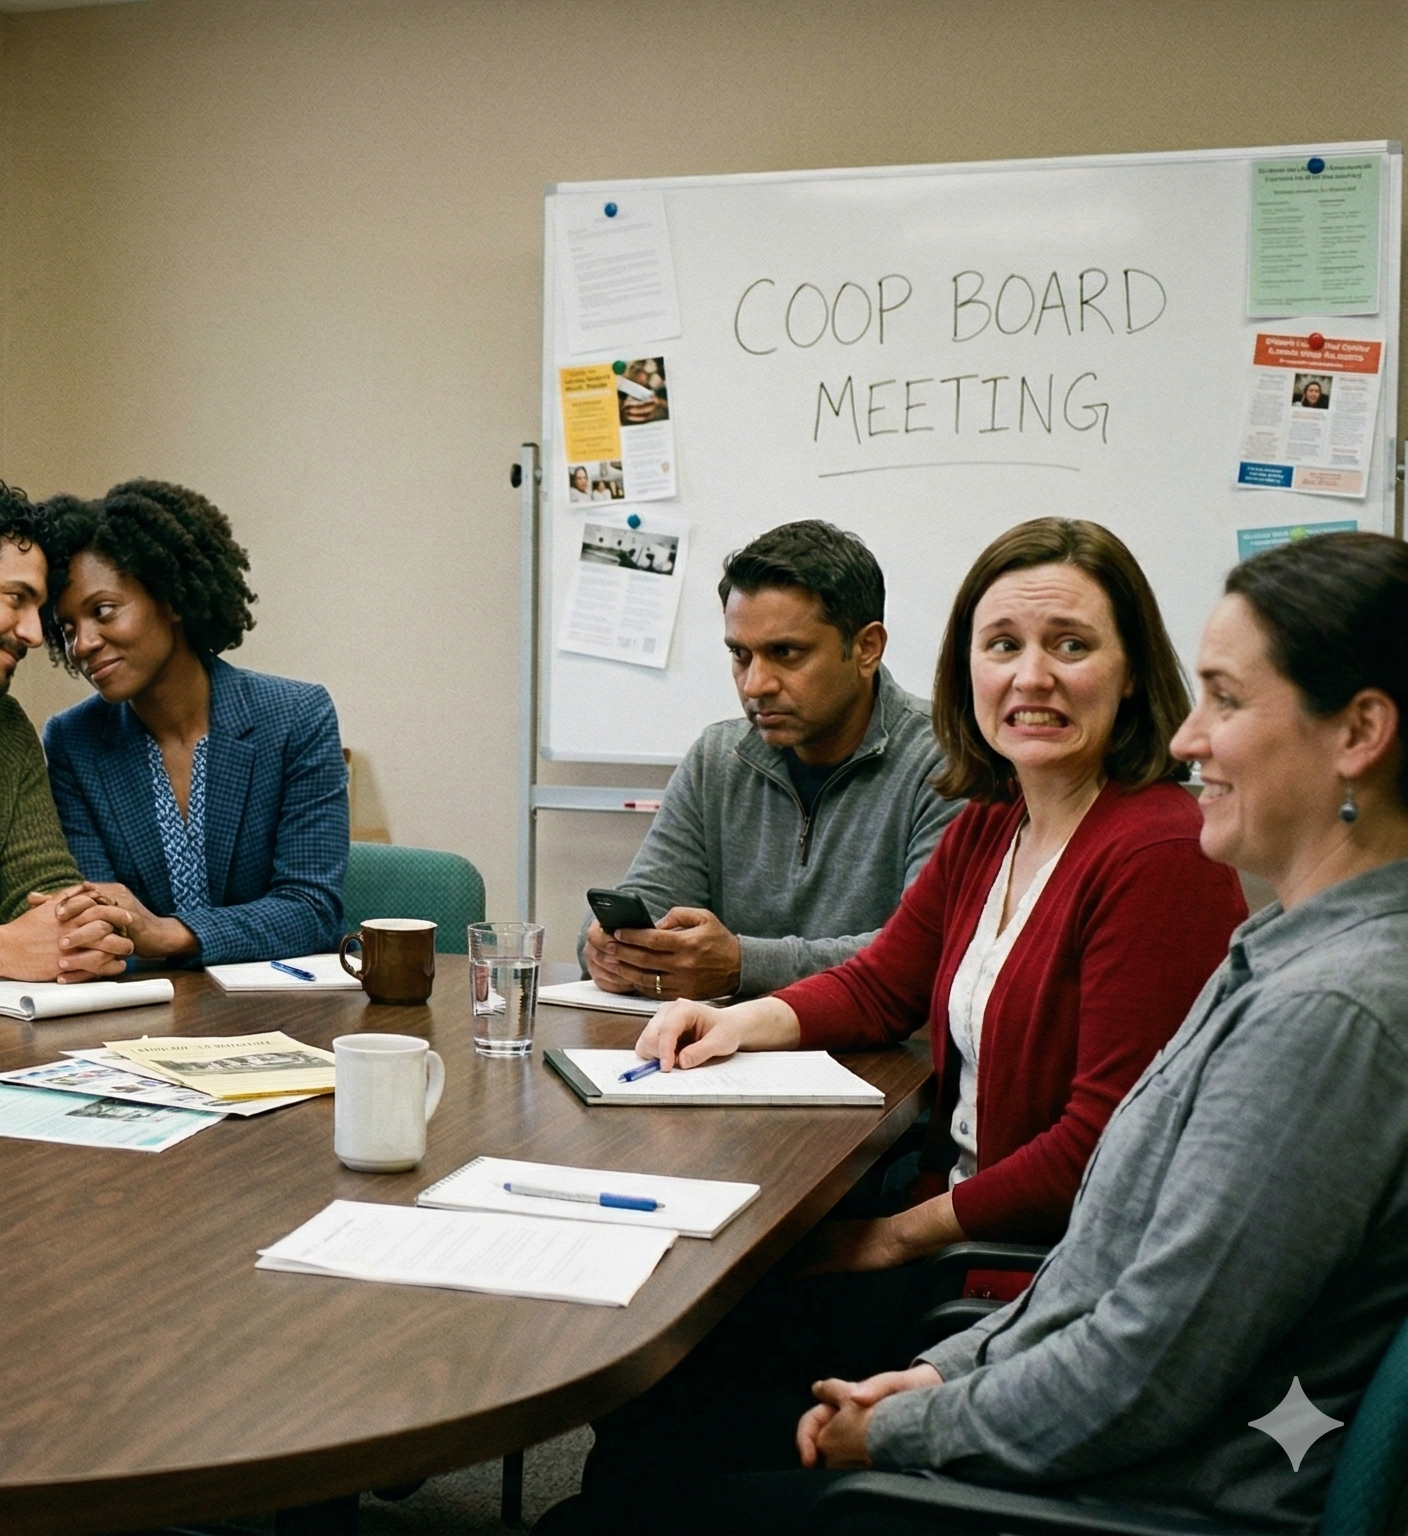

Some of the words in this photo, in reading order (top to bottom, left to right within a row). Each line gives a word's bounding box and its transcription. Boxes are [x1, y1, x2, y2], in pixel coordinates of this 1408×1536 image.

[733, 274, 913, 356] COOP
[951, 268, 1167, 343] BOARD
[813, 372, 1110, 445] MEETING
